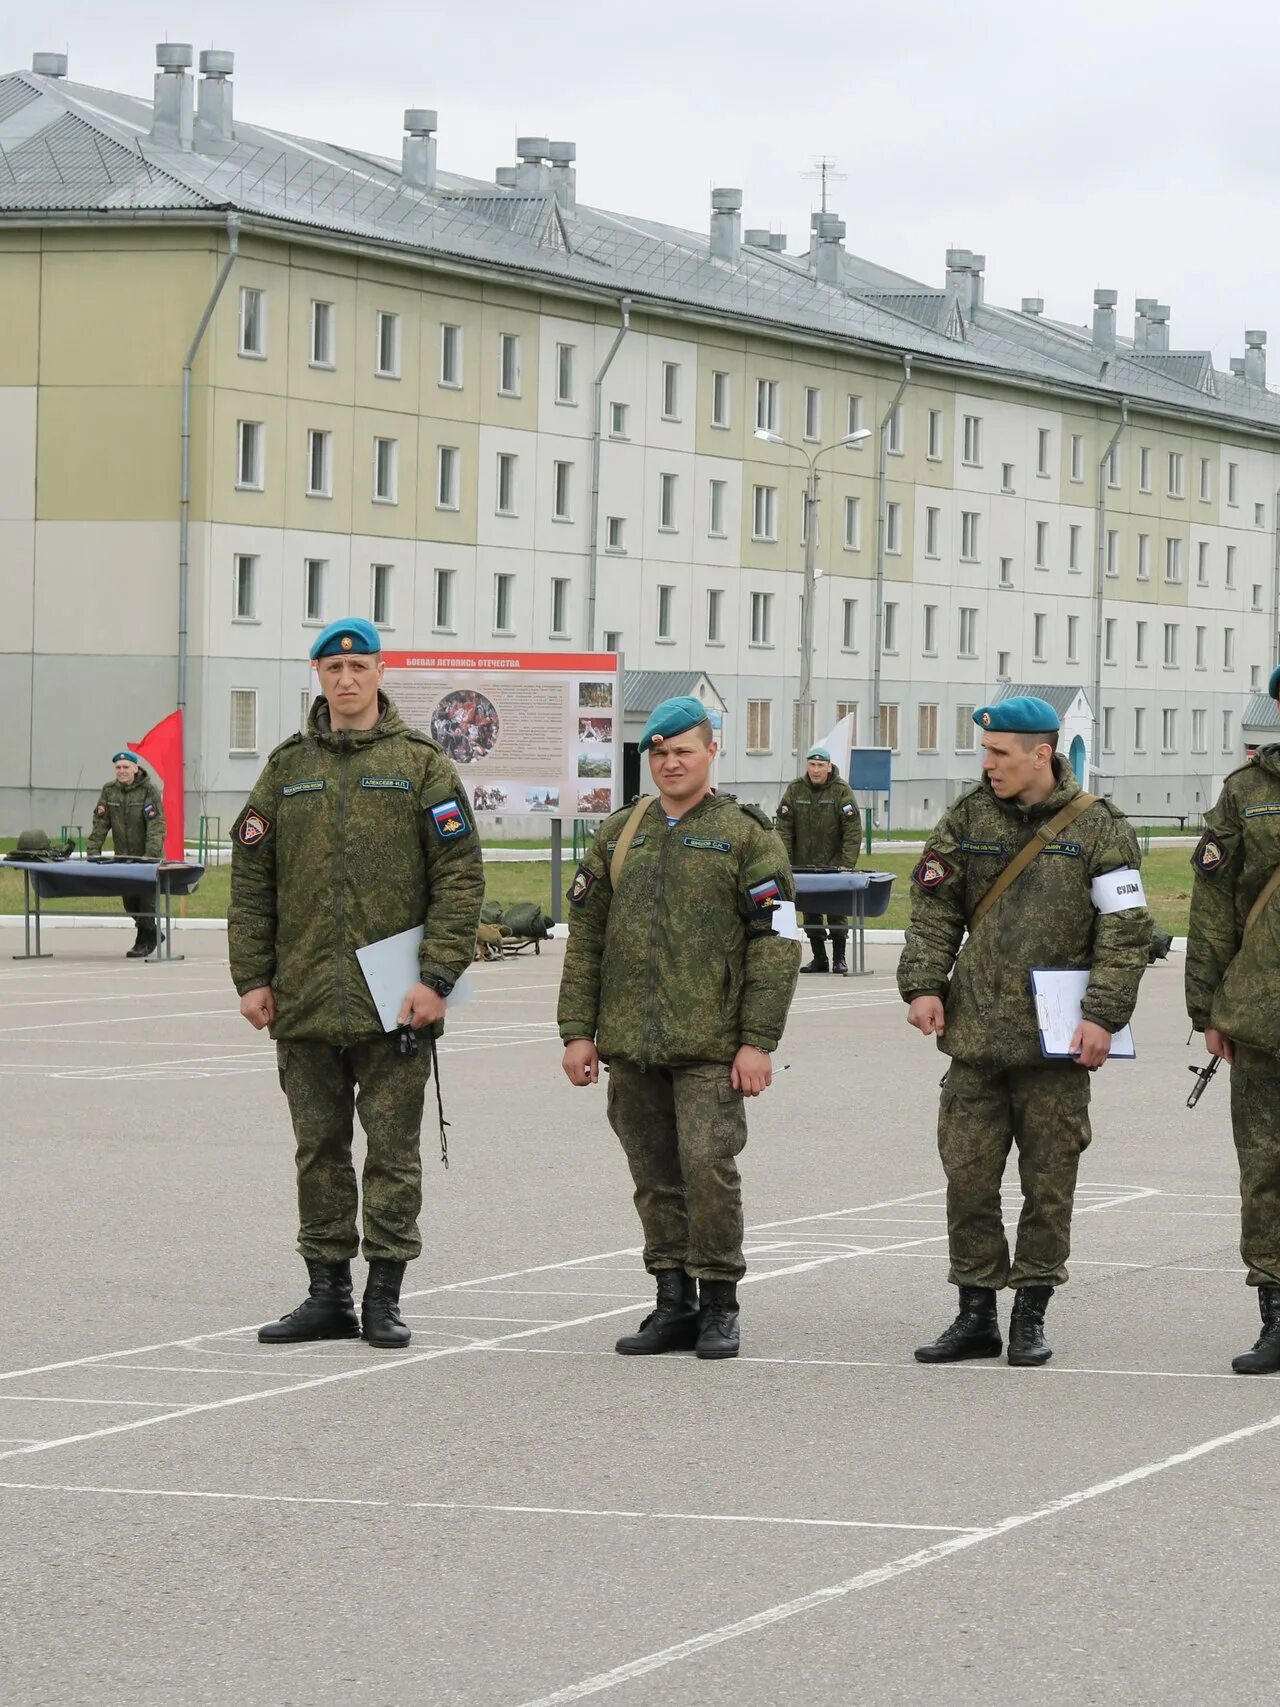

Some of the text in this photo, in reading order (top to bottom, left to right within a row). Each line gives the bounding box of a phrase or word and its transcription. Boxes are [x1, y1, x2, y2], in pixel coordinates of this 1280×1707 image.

[406, 658, 520, 668] БОЕВАЯ ЛЕТОПИСЬ ОТЕЧЕСТВА
